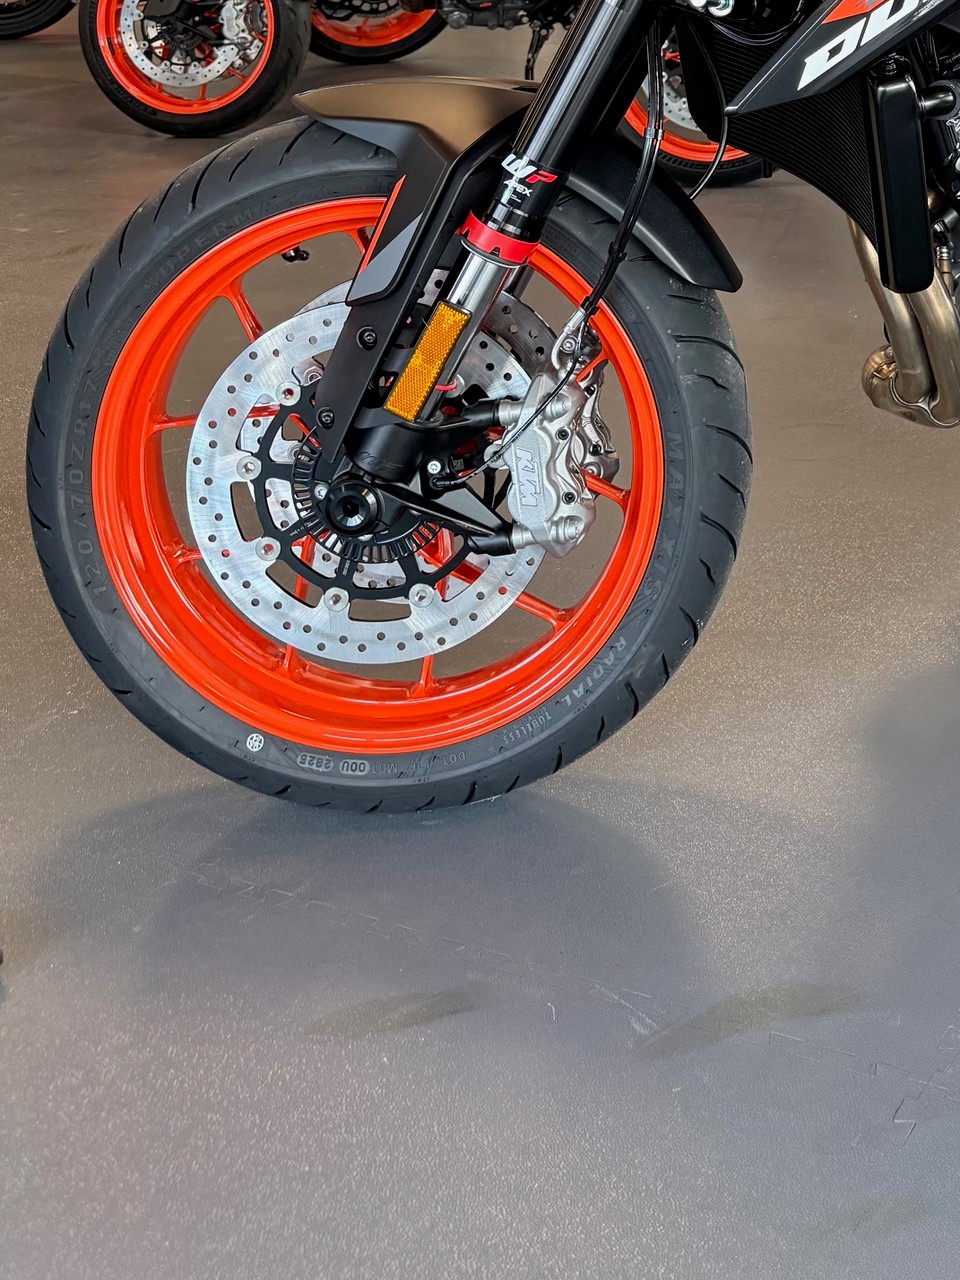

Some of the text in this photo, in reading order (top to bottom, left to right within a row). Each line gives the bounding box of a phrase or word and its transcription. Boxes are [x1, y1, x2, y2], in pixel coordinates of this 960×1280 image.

[501, 153, 558, 184] WP
[503, 179, 533, 197] APEX
[515, 446, 542, 508] KTM
[644, 430, 685, 600] MAXXIS
[562, 635, 627, 707] RADIAL
[503, 711, 552, 745] TUBELESS
[443, 751, 467, 766] DOT
